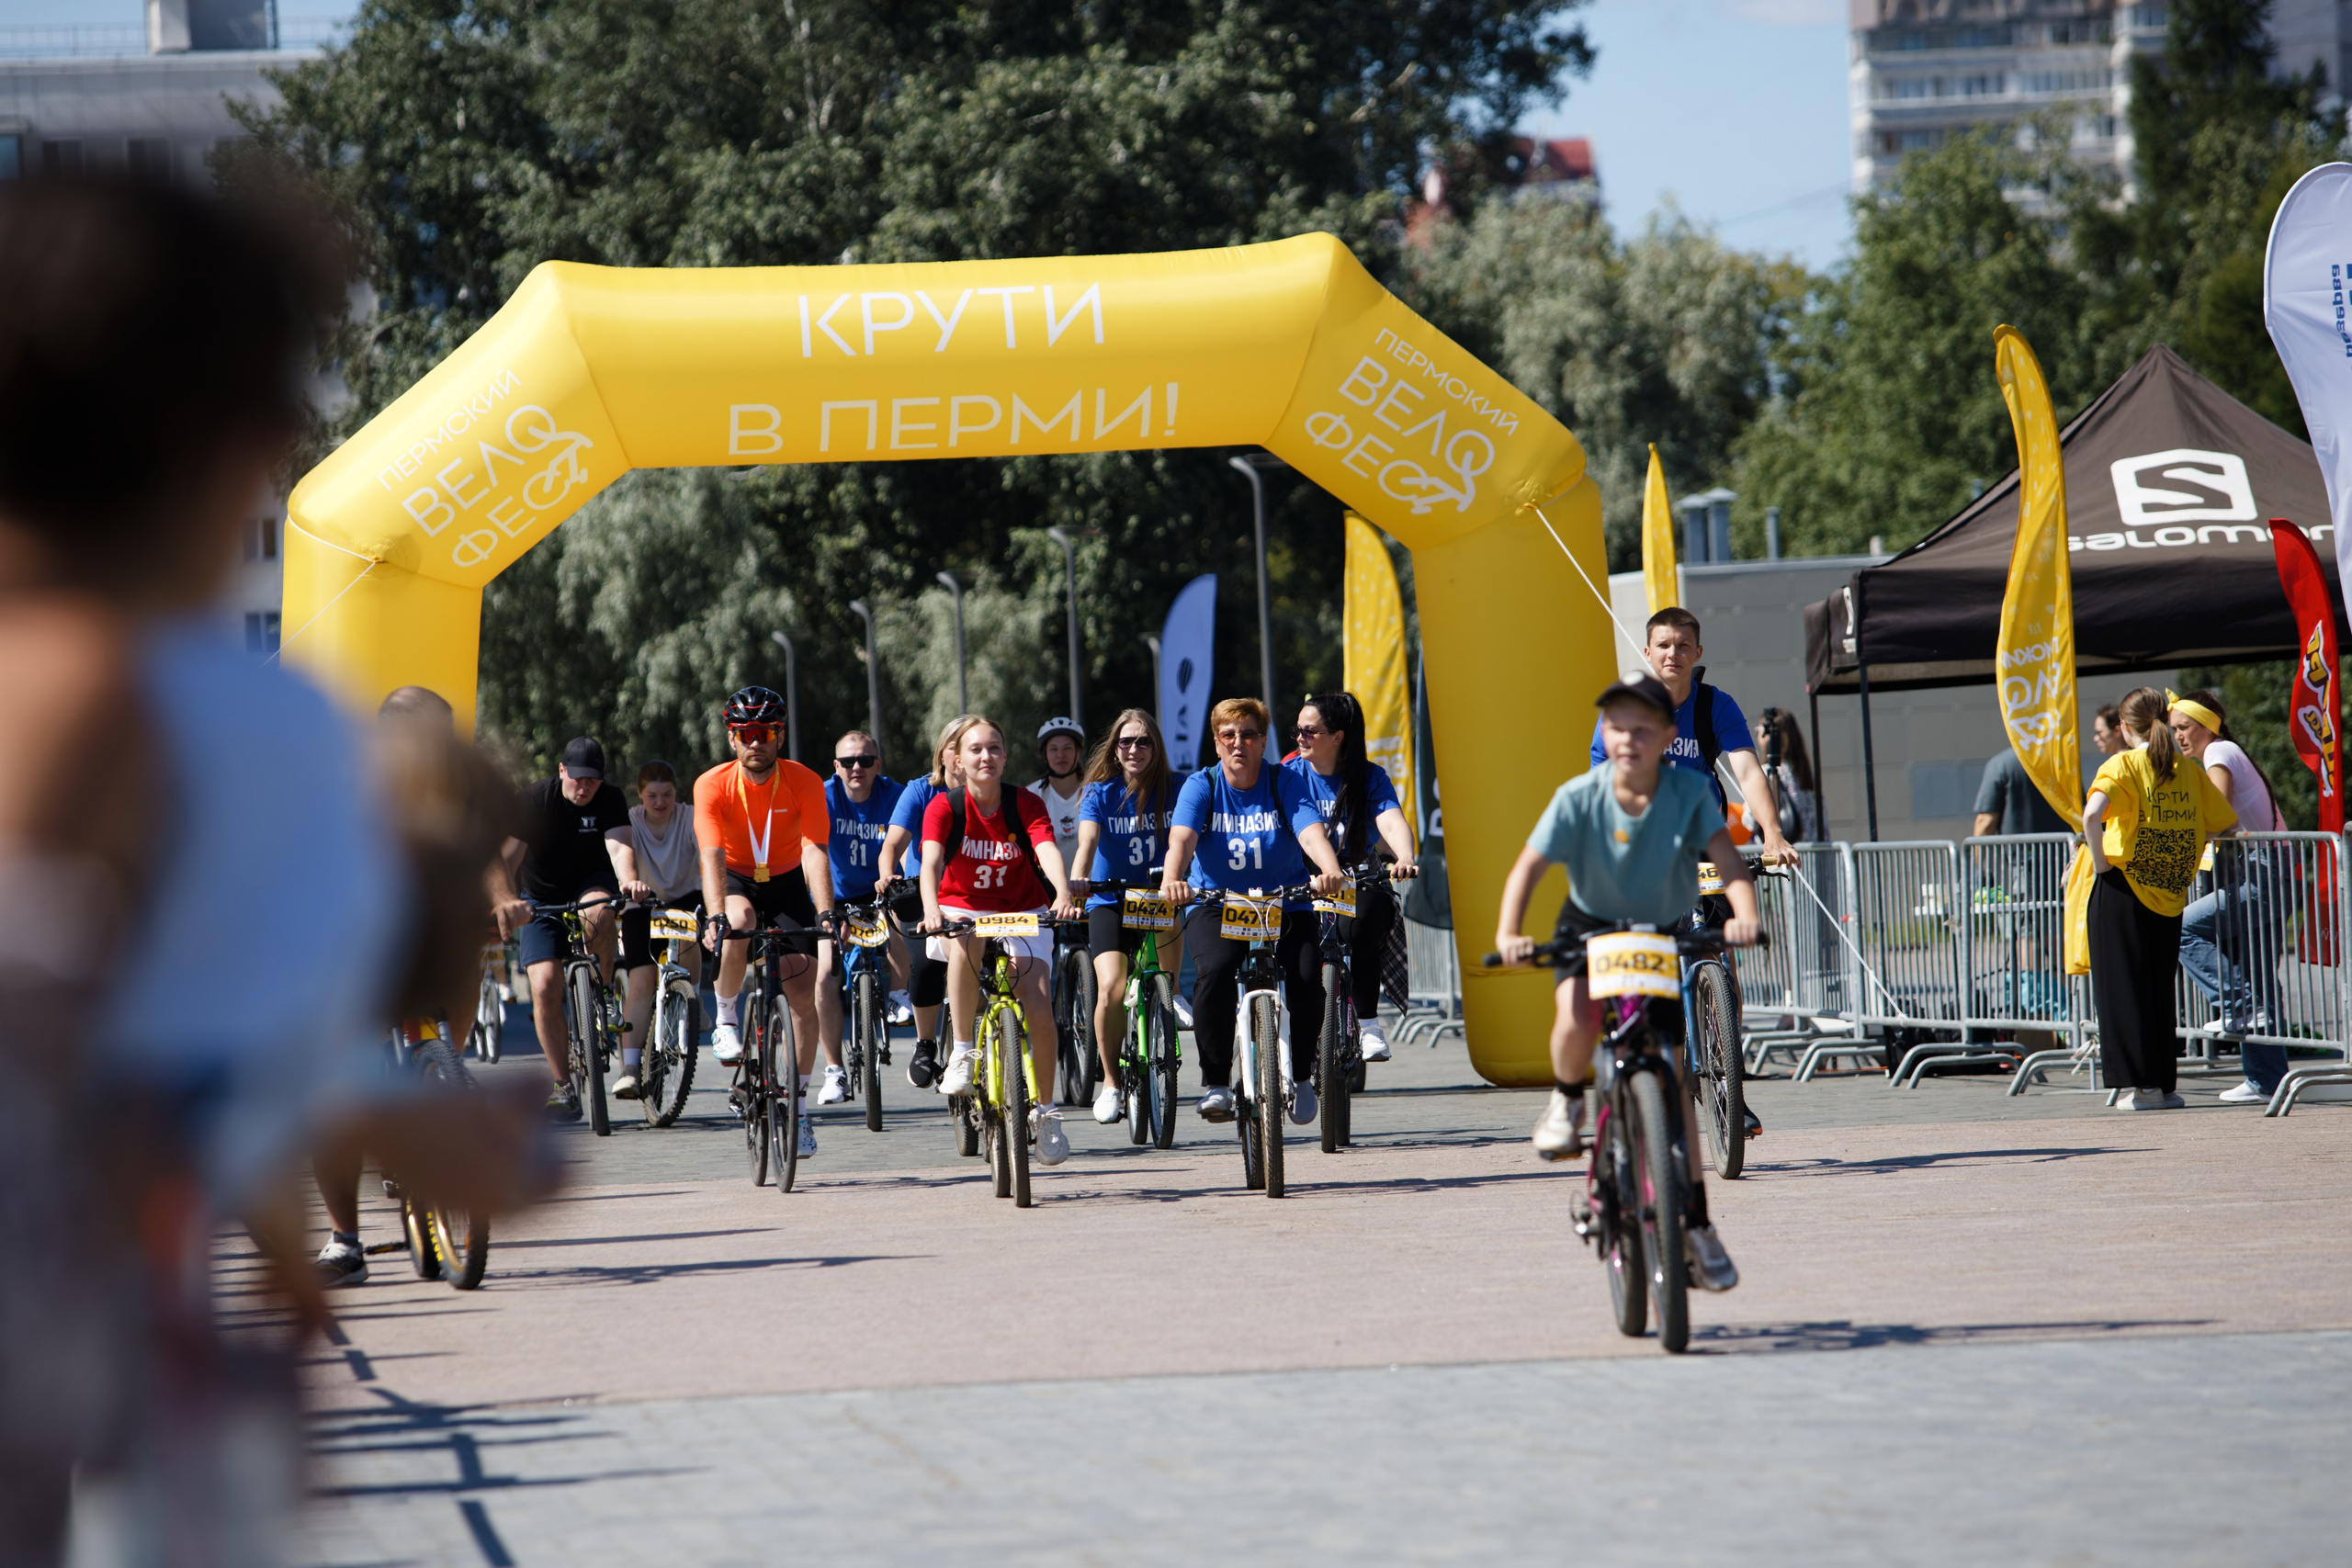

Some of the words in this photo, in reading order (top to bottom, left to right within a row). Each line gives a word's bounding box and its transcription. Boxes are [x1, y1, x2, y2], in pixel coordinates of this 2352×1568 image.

[797, 282, 1104, 357] КРУТИ
[1374, 328, 1519, 436] ПЕРМСКИЙ
[376, 367, 521, 491] ПЕРМСКИЙ
[728, 403, 783, 456] В
[819, 382, 1179, 453] ПЕРМИ!
[1211, 809, 1282, 833] ИМНАЗИЯ
[849, 840, 867, 866] 31
[1128, 835, 1156, 865] 31
[1228, 837, 1262, 871] 31
[974, 864, 1008, 889] 31
[978, 916, 1029, 925] 0984
[1595, 952, 1664, 973] 0482
